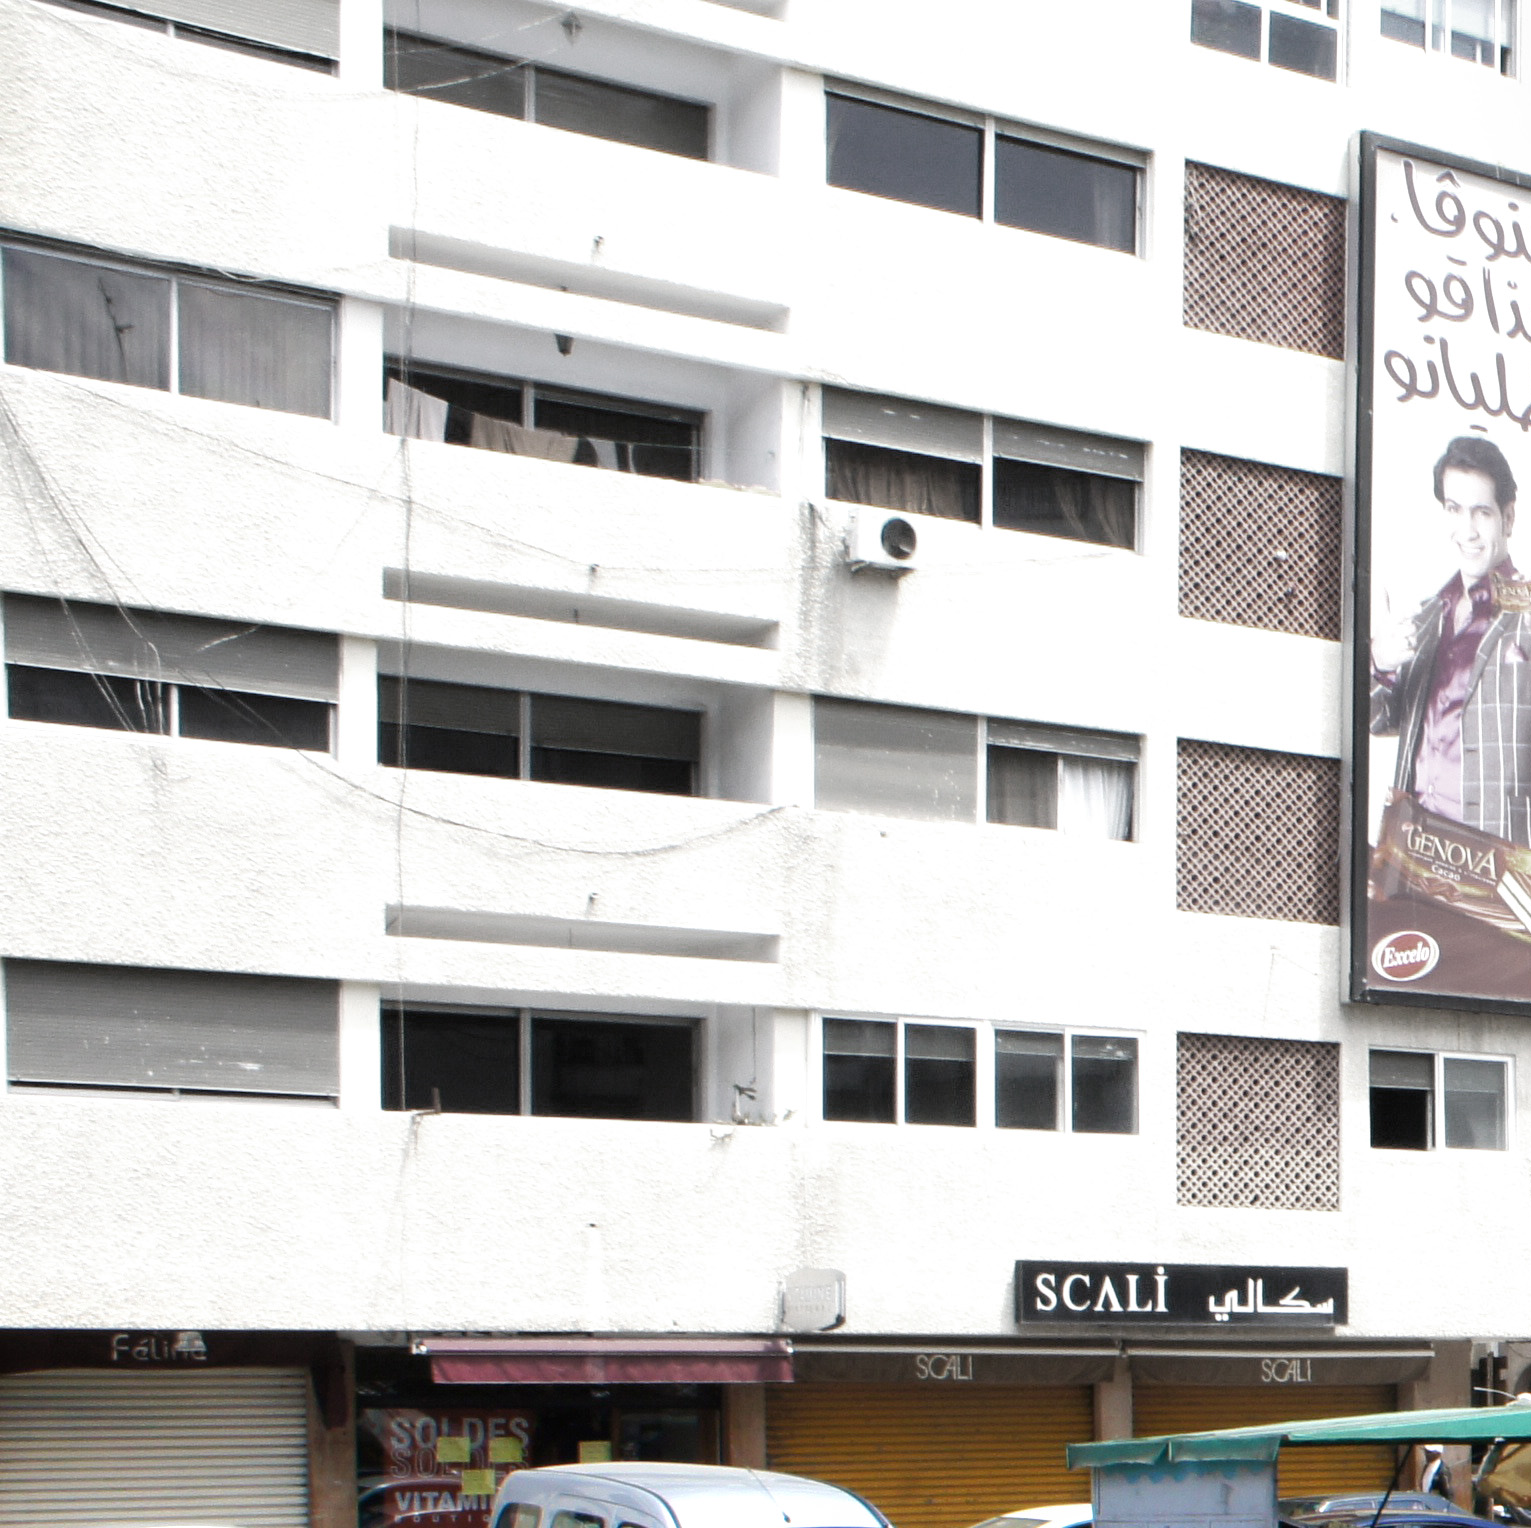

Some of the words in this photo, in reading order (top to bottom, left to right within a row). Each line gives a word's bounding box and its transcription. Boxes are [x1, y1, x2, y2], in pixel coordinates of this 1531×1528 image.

[1402, 822, 1498, 881] GENOVA
[1431, 864, 1461, 882] Cacao
[1382, 941, 1431, 968] Excelo
[1208, 1277, 1335, 1322] سكالي
[916, 1354, 973, 1380] SCALI
[1261, 1358, 1312, 1383] SCALI
